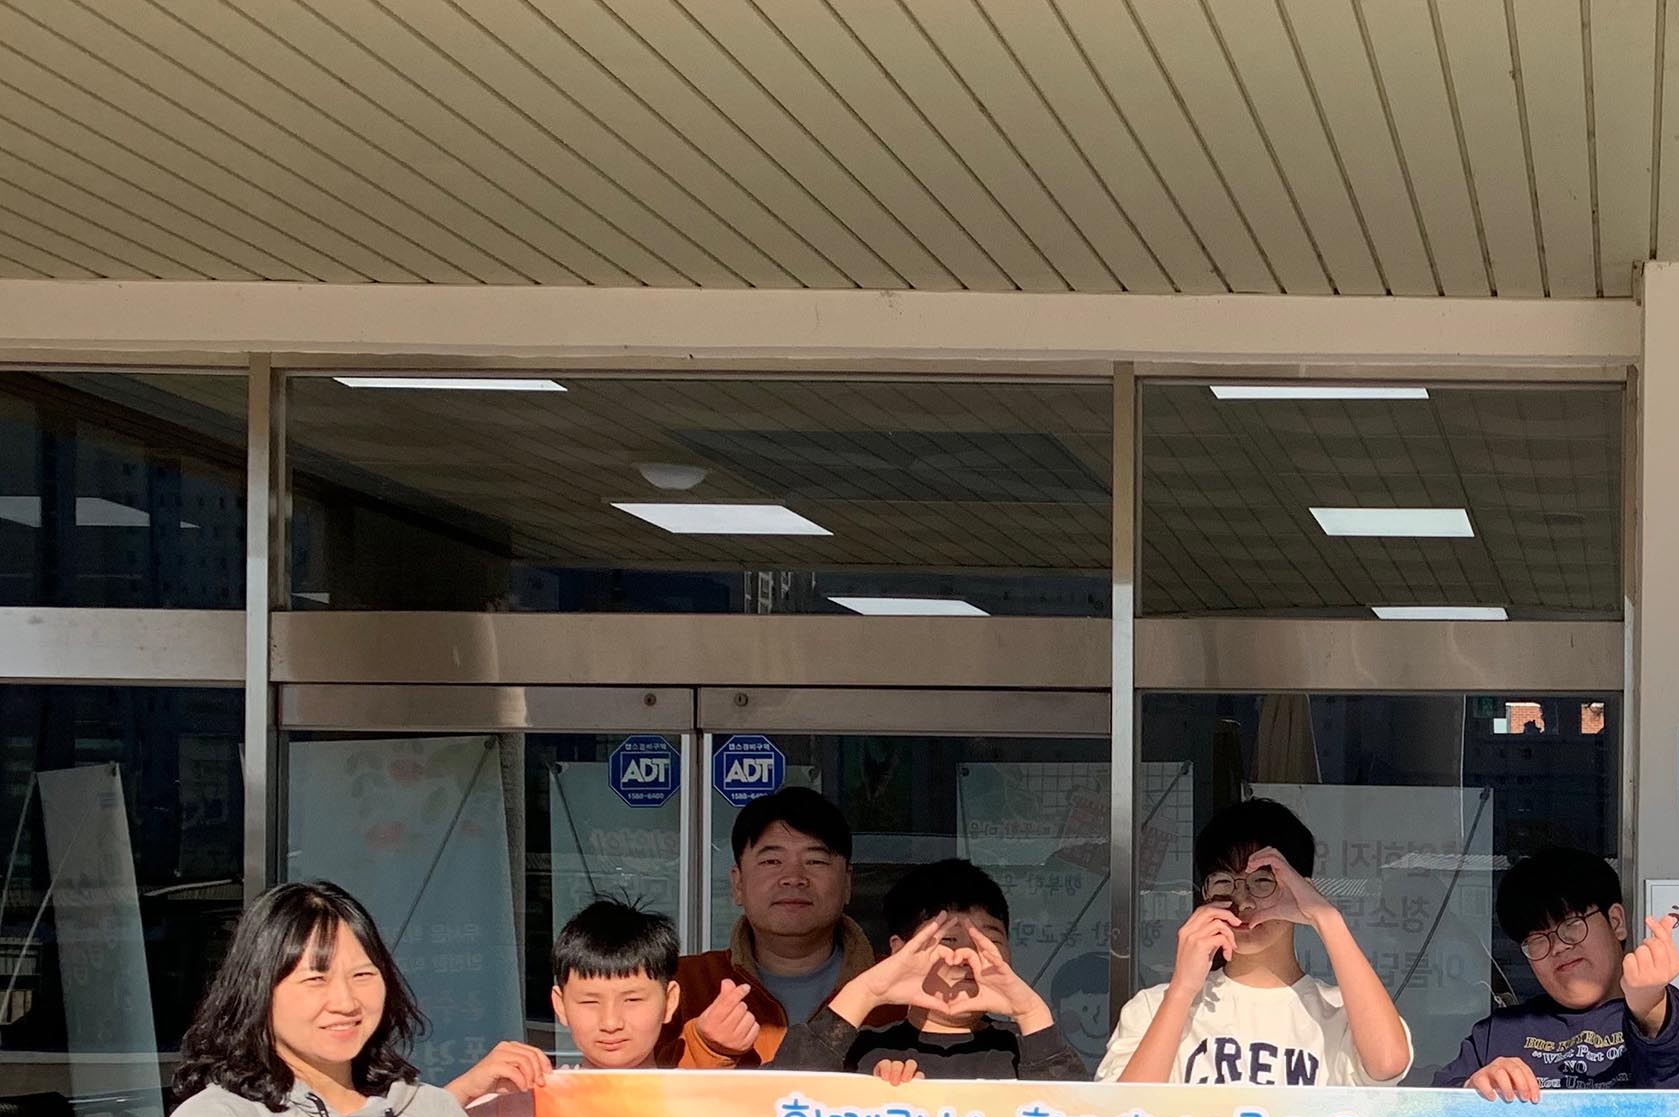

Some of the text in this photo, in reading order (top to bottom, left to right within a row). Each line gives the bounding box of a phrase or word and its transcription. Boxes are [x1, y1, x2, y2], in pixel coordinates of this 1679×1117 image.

[621, 758, 670, 783] ADT
[725, 758, 773, 783] ADT
[1184, 1037, 1319, 1086] CREW
[1562, 1060, 1587, 1073] NO
